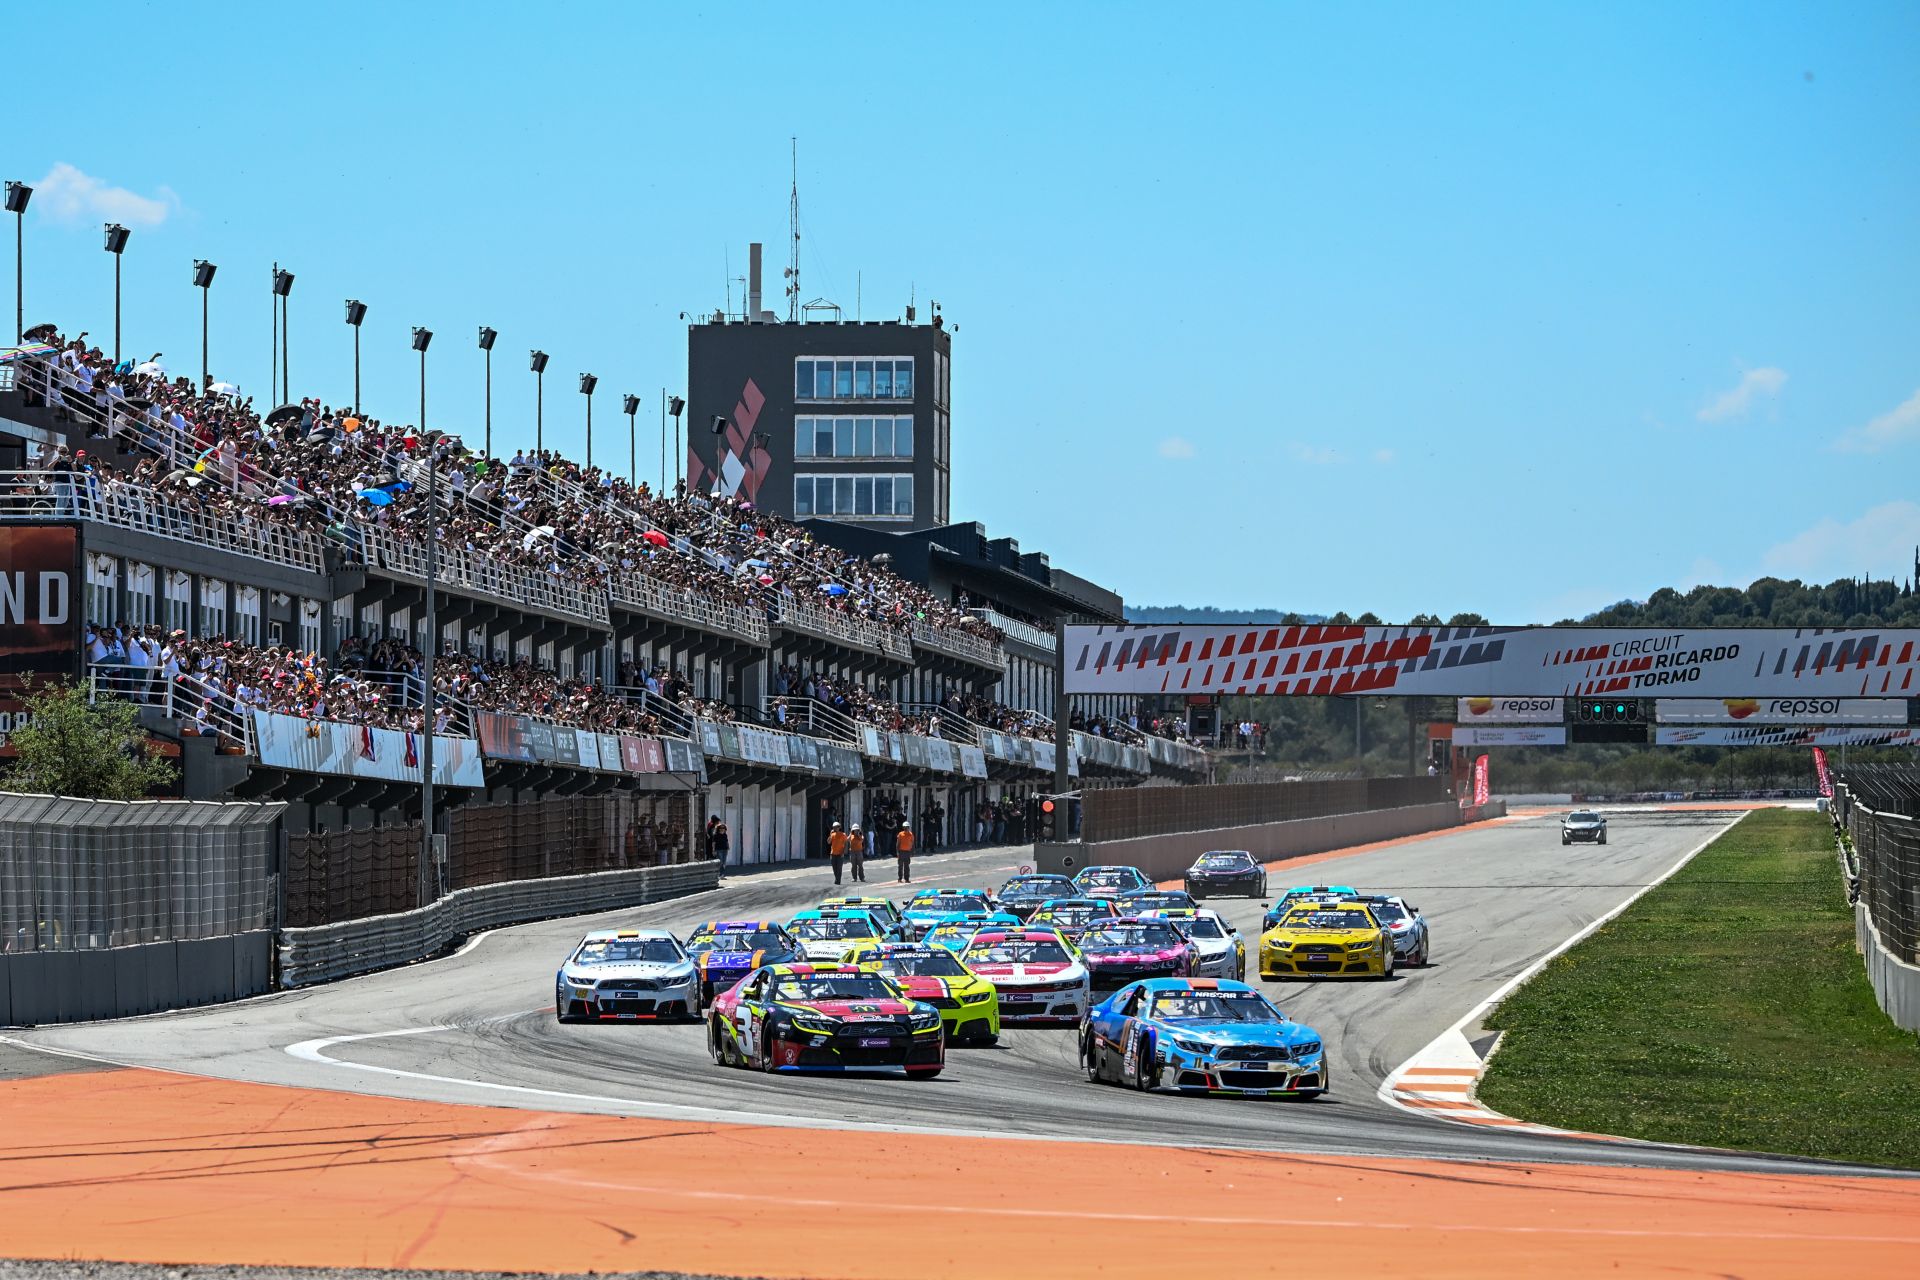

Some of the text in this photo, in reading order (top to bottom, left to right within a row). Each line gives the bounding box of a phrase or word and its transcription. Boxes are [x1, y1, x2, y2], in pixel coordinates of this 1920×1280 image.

[1612, 634, 1685, 657] CIRCUIT
[1655, 644, 1740, 669] RICARDO
[1634, 667, 1701, 689] TORMO
[1195, 991, 1237, 999] NASCAR
[735, 1006, 754, 1057] 3
